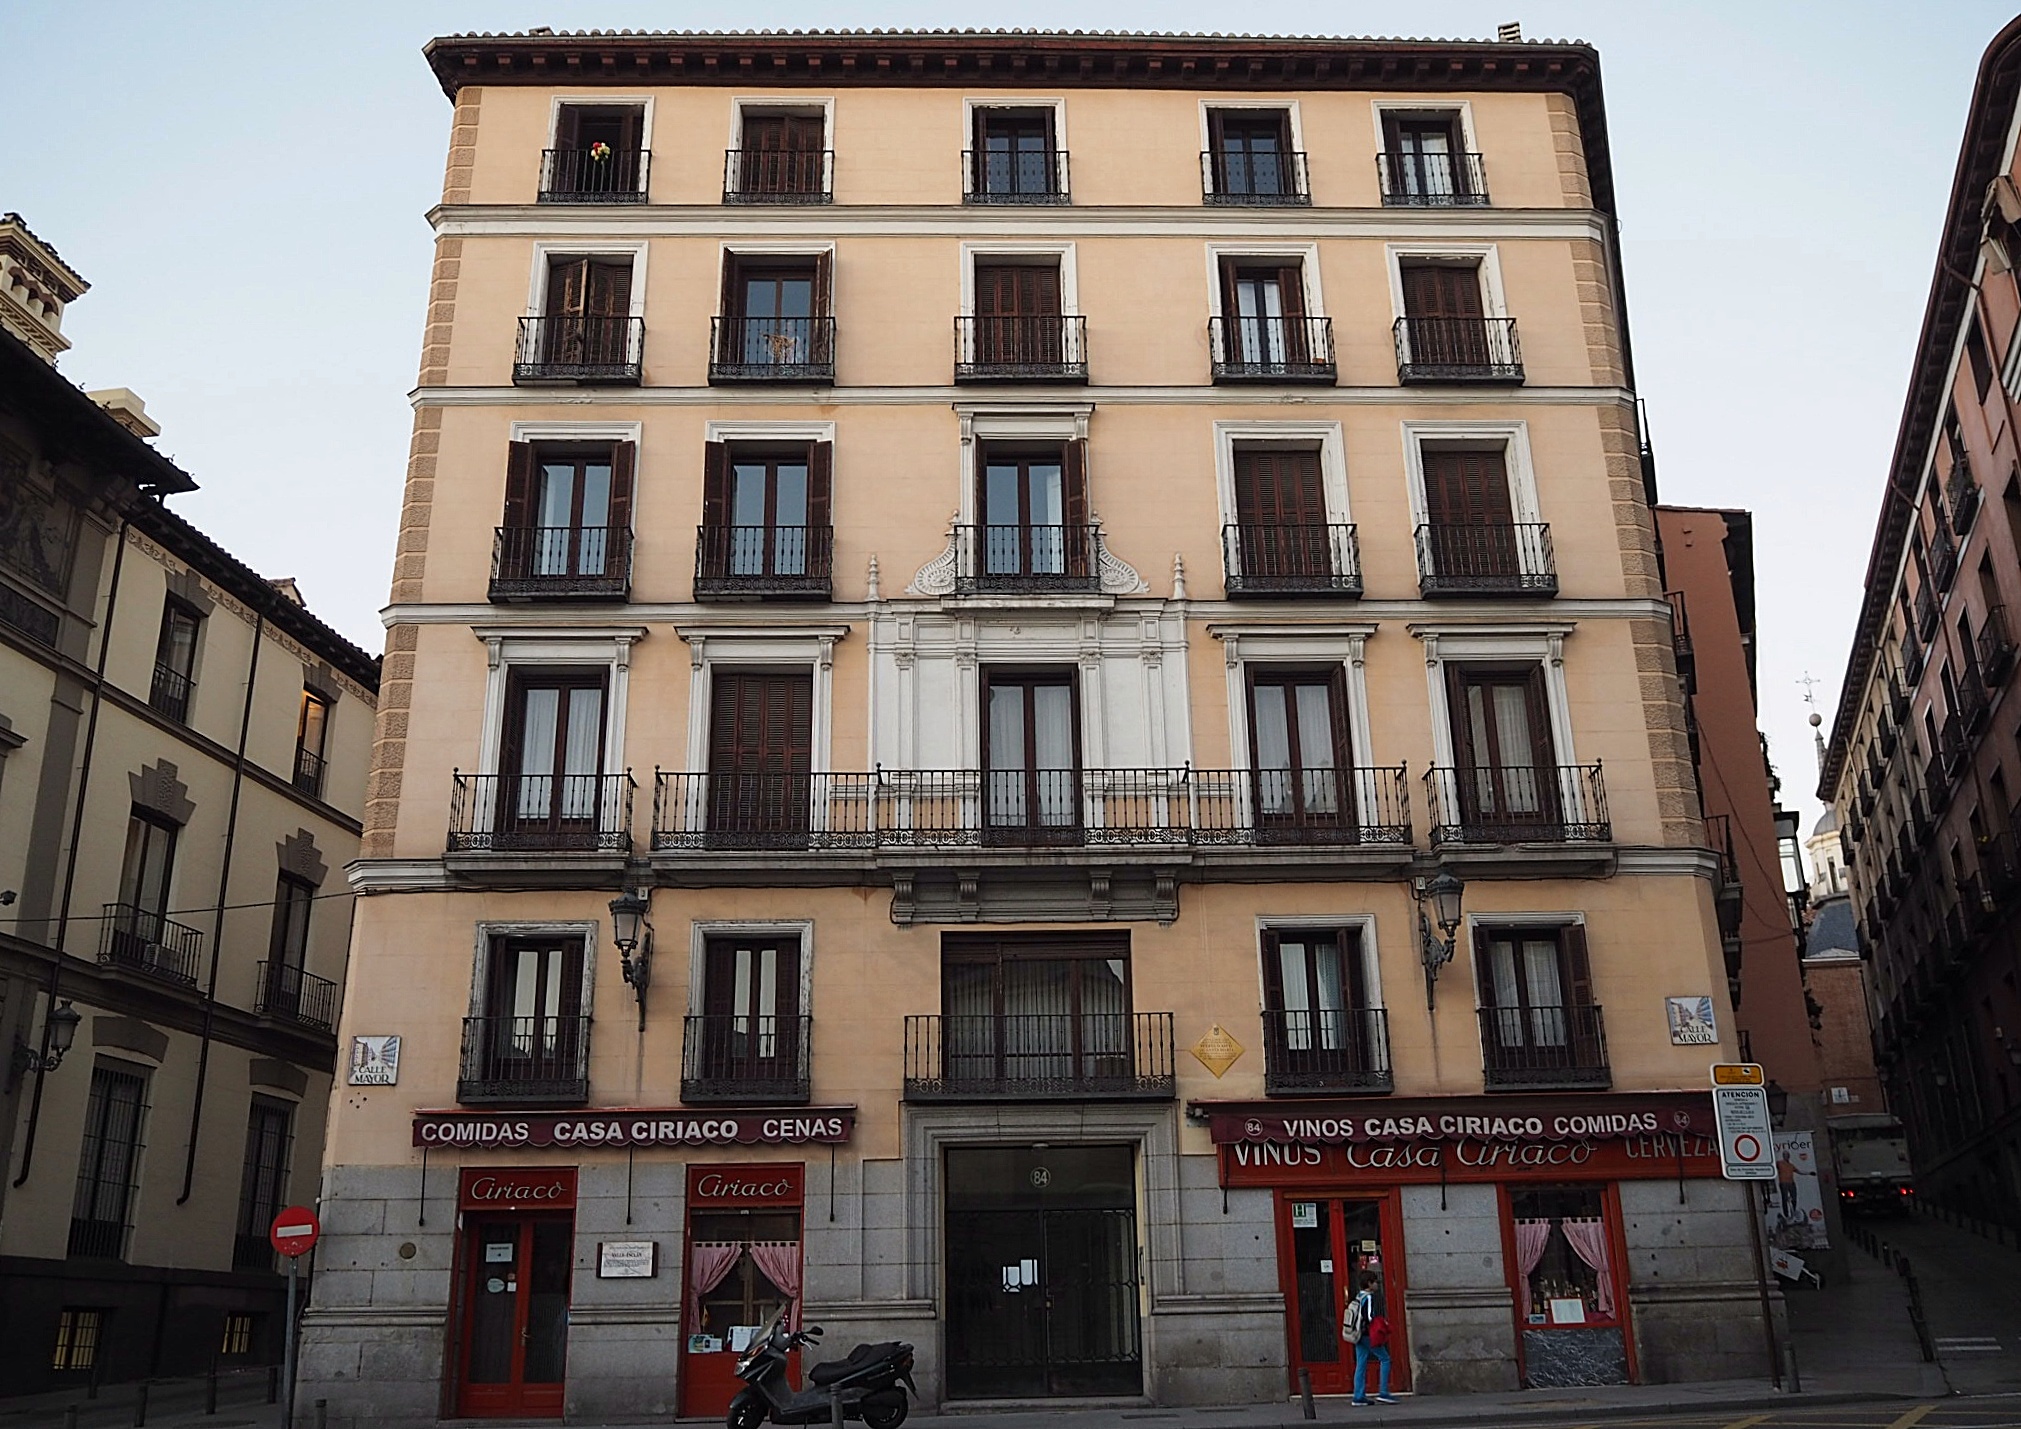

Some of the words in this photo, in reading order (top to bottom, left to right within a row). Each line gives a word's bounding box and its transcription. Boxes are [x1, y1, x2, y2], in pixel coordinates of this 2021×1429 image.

[1680, 1025, 1706, 1033] CALLE
[1678, 1033, 1713, 1043] MAYOR
[358, 1065, 387, 1073] CALLE
[355, 1074, 390, 1084] MAYOR
[1722, 1090, 1760, 1098] ATENCIÓN
[421, 1122, 529, 1141] COMIDAS
[553, 1122, 624, 1140] CASA
[631, 1119, 738, 1139] CIRIACO
[763, 1118, 842, 1137] CENAS
[1247, 1122, 1261, 1133] 84
[1283, 1119, 1354, 1137] VINOS
[1364, 1116, 1434, 1136] CASA
[1439, 1115, 1543, 1135] CIRIACO
[1553, 1112, 1658, 1135] COMIDAS
[1346, 1142, 1441, 1168] Casa
[1456, 1138, 1597, 1166] Ciriaco
[1033, 1170, 1048, 1184] 84
[471, 1176, 568, 1200] Ciriaco
[698, 1173, 794, 1197] Ciriaco
